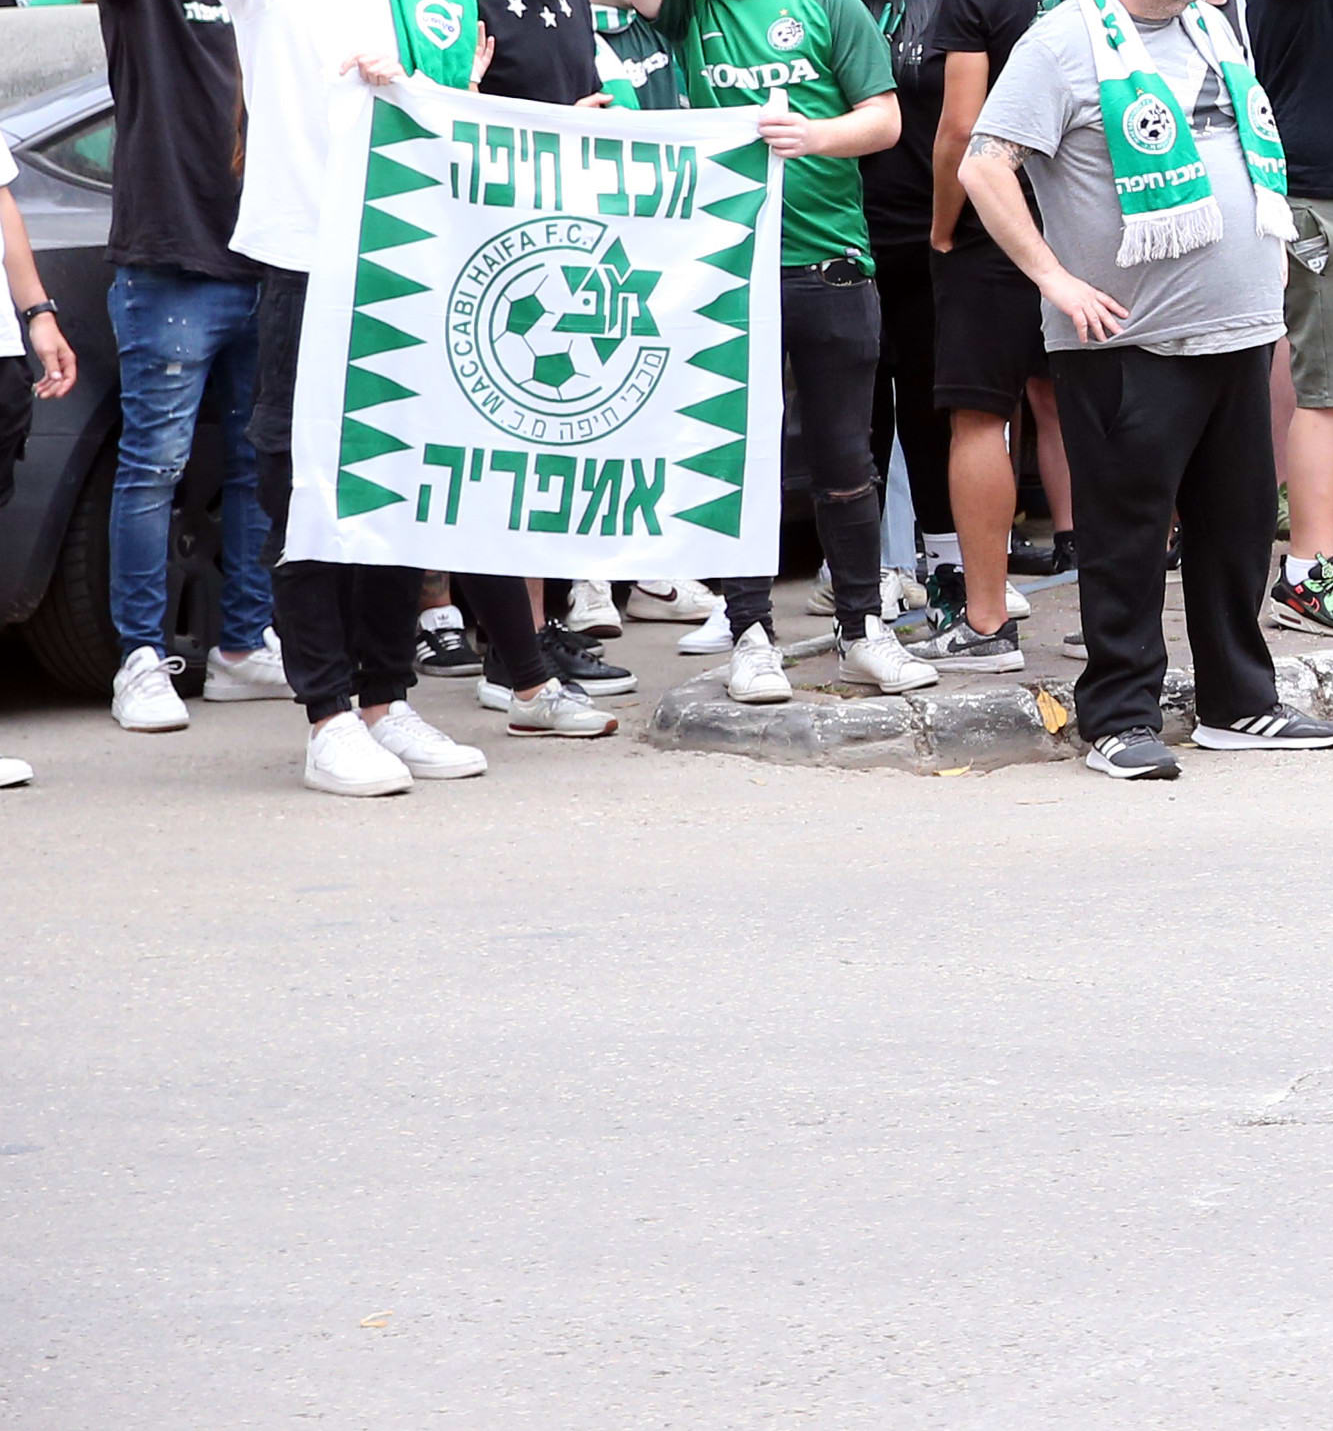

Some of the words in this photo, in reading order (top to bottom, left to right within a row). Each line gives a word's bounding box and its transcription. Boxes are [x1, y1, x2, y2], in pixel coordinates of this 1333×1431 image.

[450, 120, 563, 212] חיפה
[581, 135, 698, 220] מכבי
[1114, 172, 1165, 195] חיפה
[466, 230, 537, 287] HAIFA
[545, 223, 588, 247] F.C.
[452, 290, 506, 416] MACCABI
[620, 353, 663, 404] מכבי
[559, 406, 620, 441] חיפה
[415, 443, 666, 537] אמפריה
